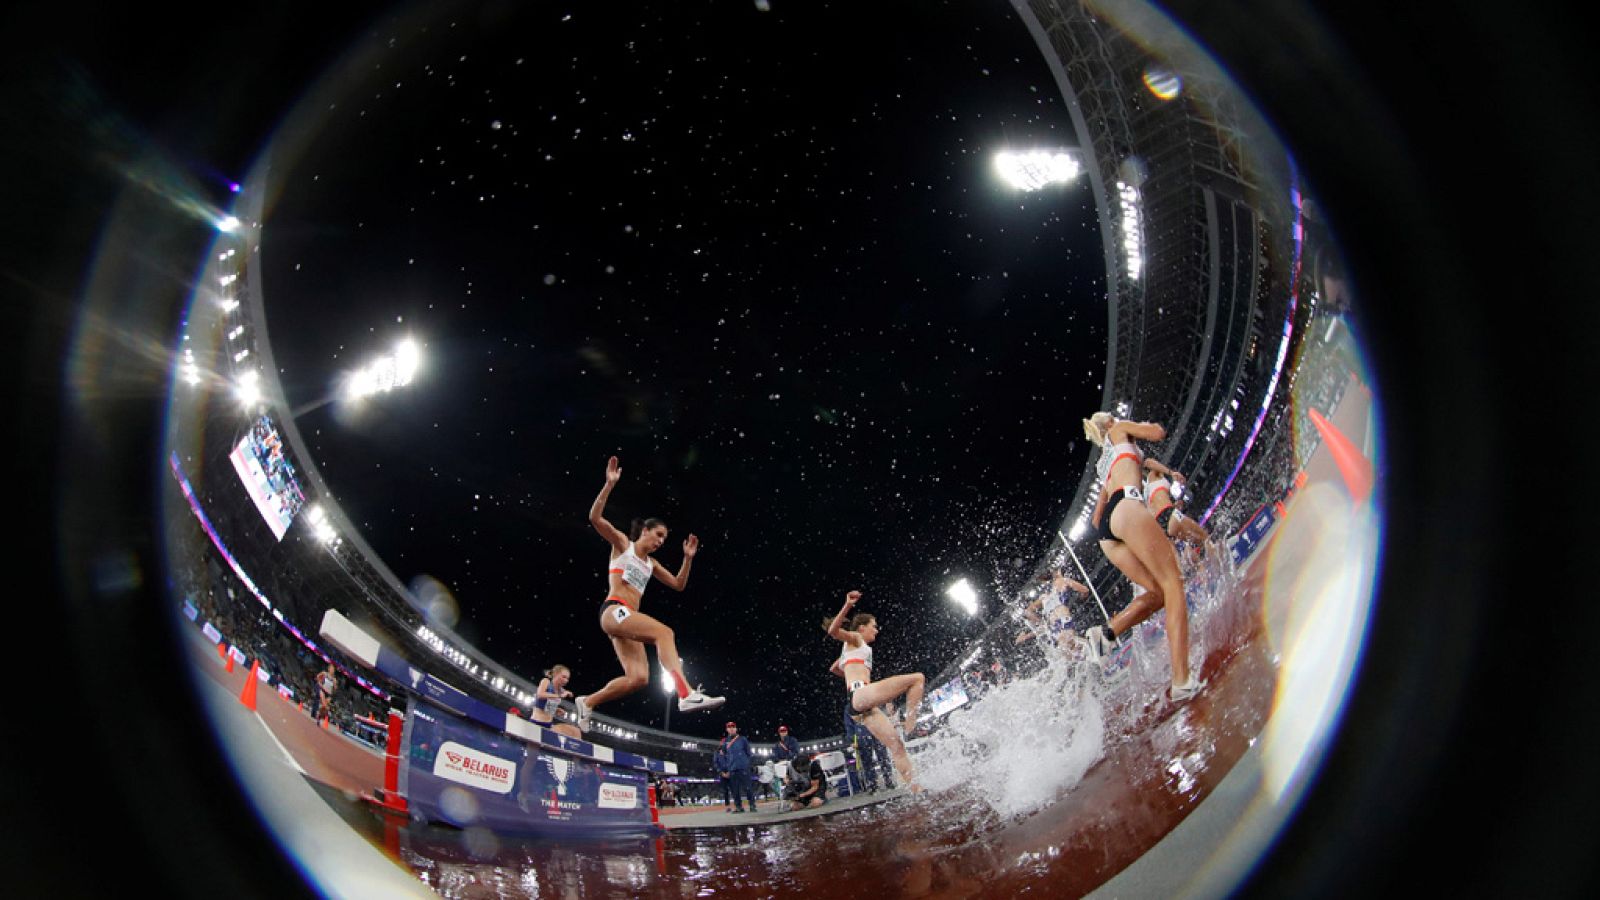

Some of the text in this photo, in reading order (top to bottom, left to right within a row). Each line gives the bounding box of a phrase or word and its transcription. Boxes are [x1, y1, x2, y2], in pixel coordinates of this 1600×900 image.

[618, 608, 625, 617] 4
[463, 757, 509, 778] BELARUS
[541, 799, 582, 810] THE MATCH
